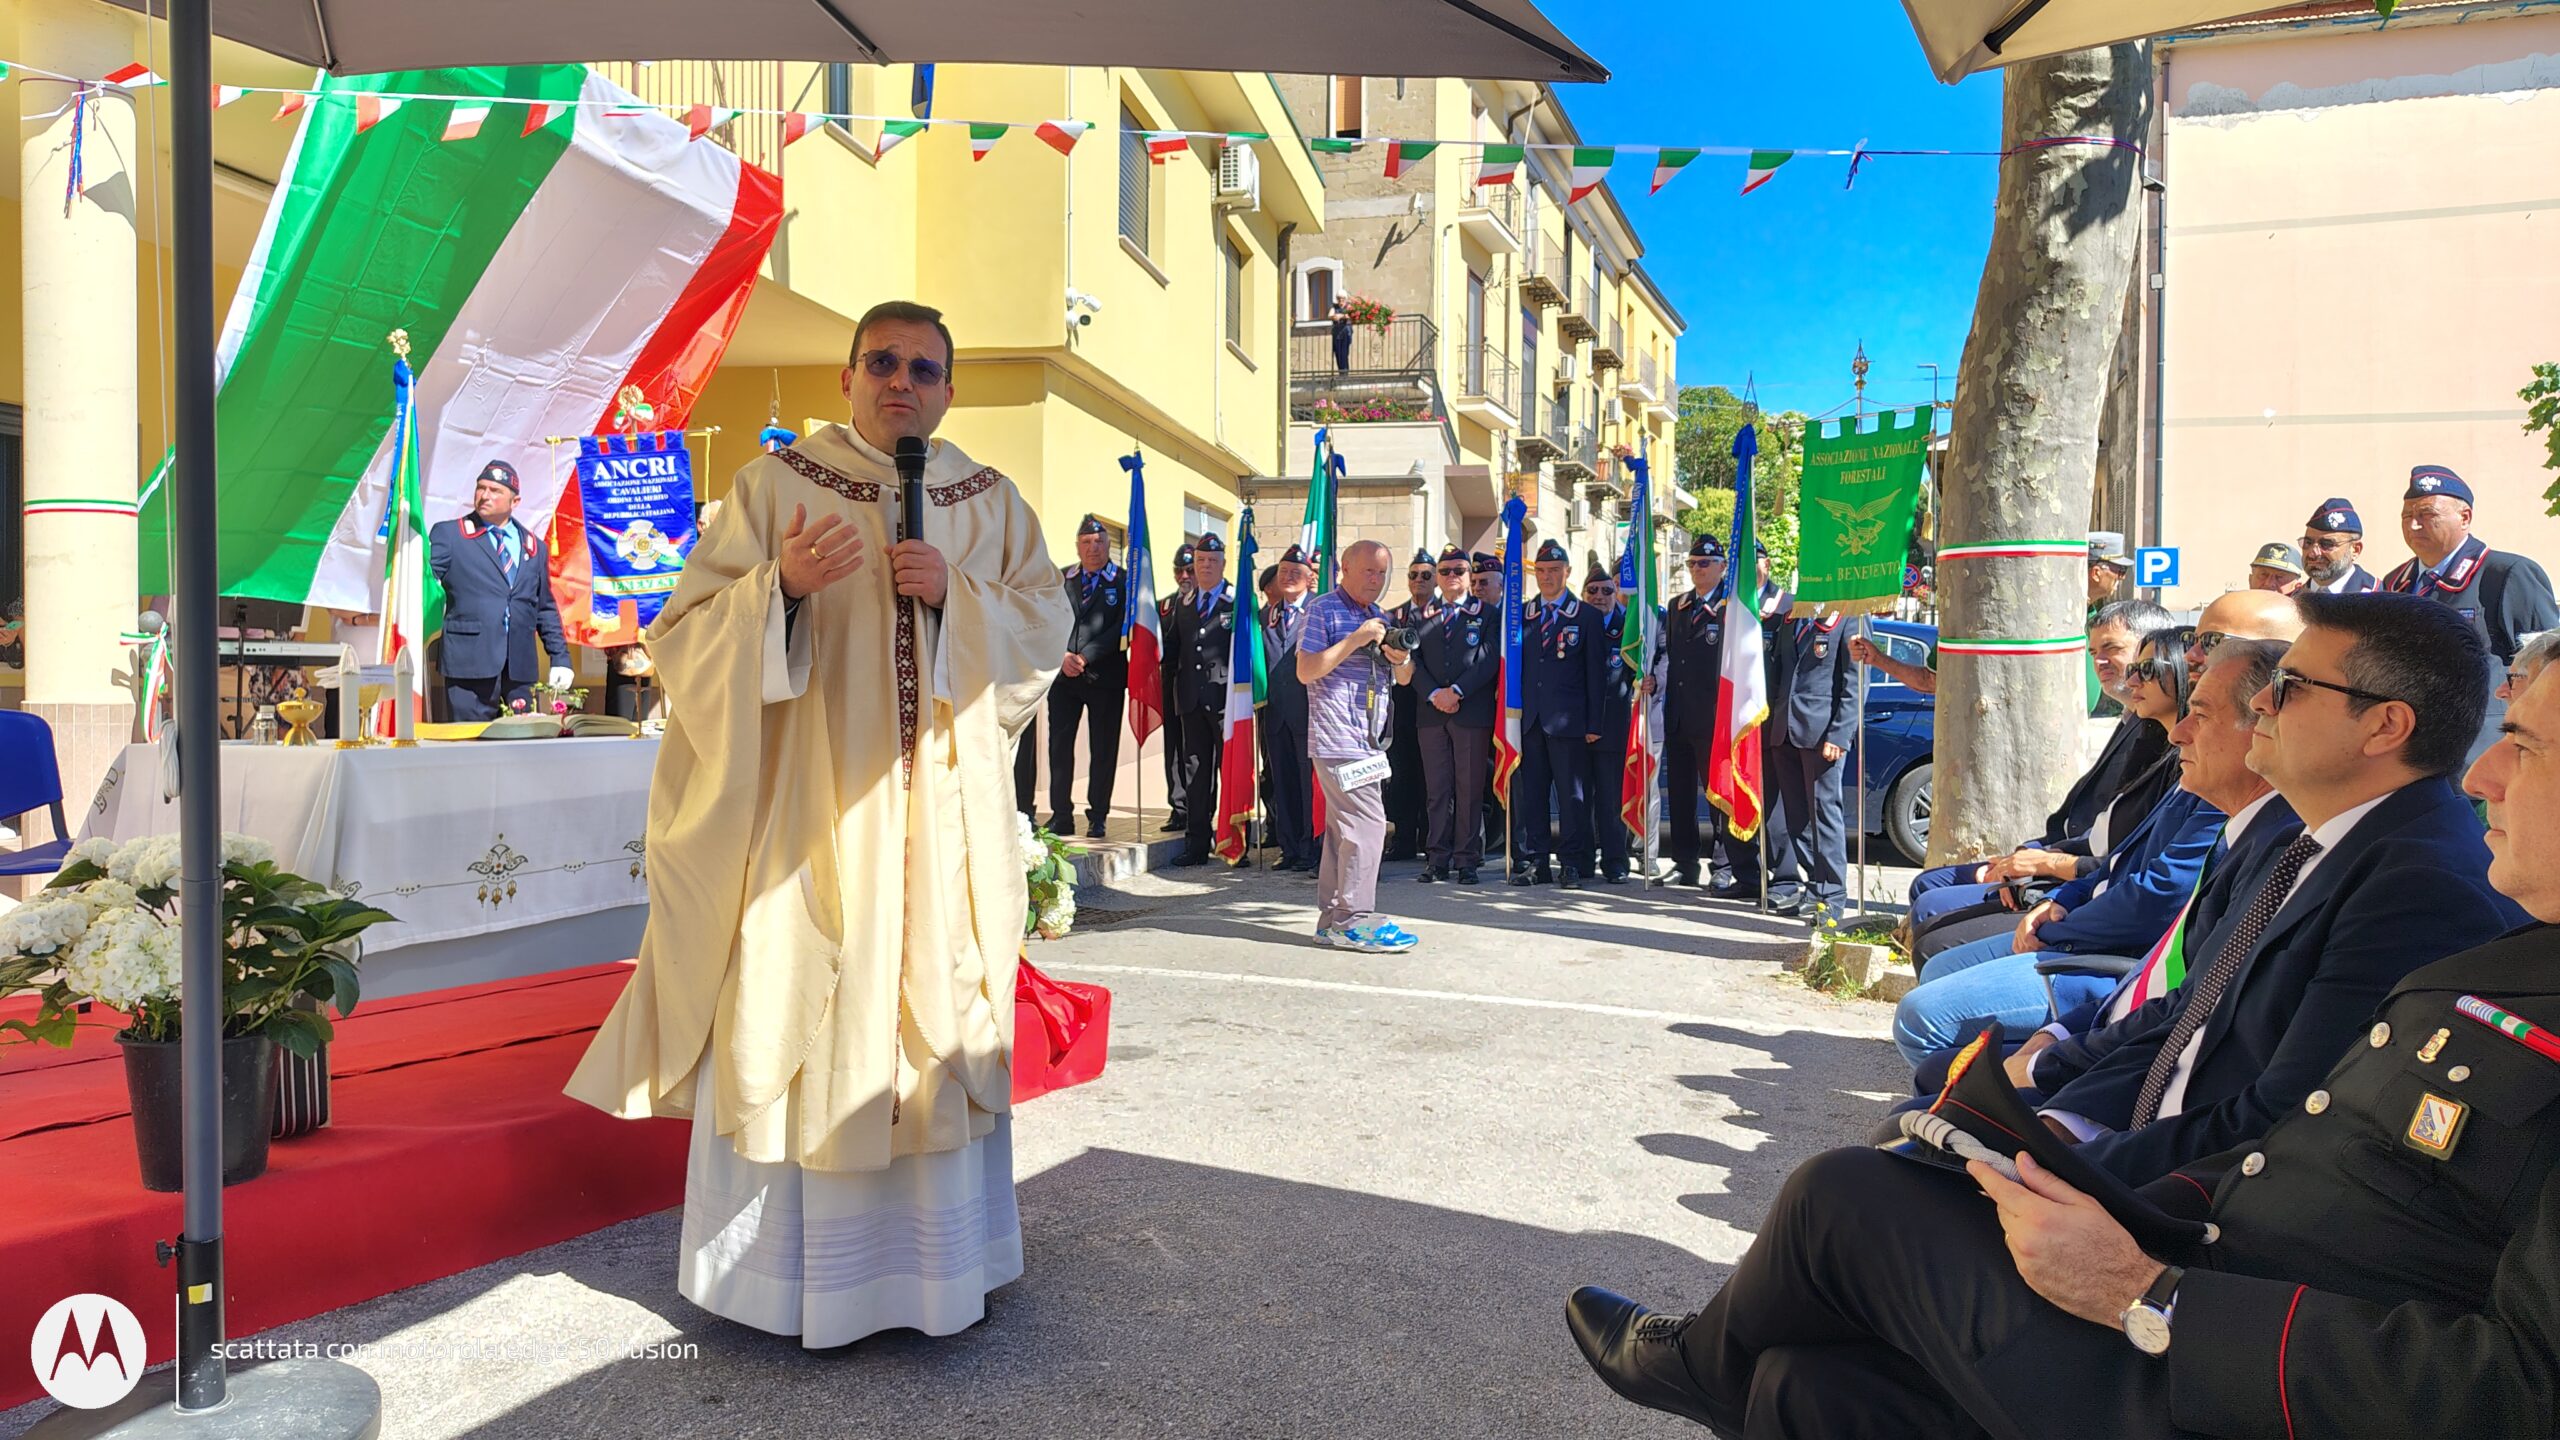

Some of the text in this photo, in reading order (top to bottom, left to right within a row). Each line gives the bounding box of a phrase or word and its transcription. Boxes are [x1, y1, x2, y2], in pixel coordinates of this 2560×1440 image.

[1809, 439, 1920, 467] ASSOCIAZIONE NAZIONALE
[593, 455, 677, 480] ANCRI
[1839, 466, 1886, 485] FORESTALI
[611, 485, 662, 496] CAVALIERI
[627, 503, 651, 511] DELLA
[1837, 561, 1901, 581] BENEVENTO
[2144, 551, 2171, 583] P
